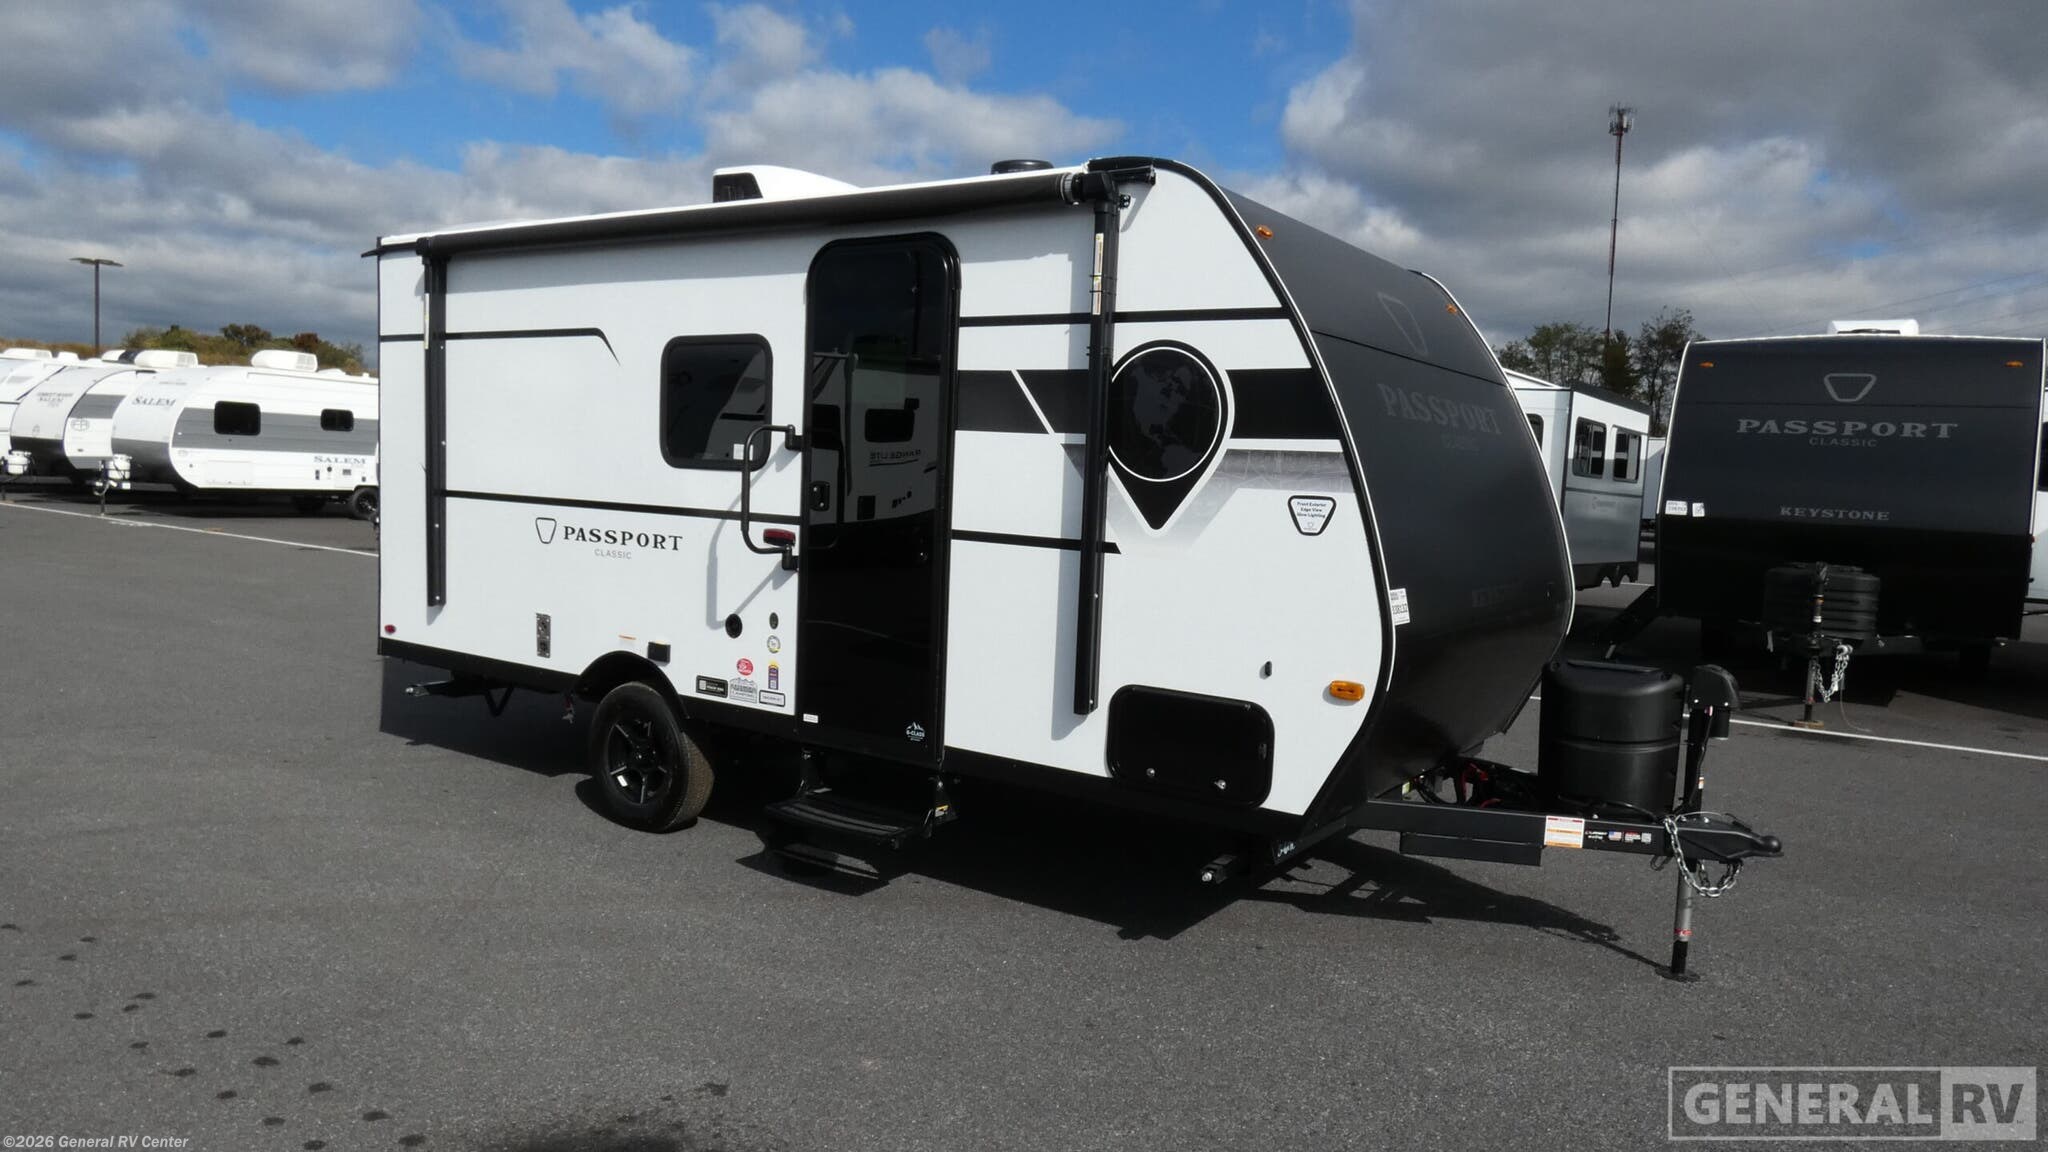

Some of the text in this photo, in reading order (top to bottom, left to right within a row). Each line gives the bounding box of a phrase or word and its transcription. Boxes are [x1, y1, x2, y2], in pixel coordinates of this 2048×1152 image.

[131, 395, 177, 407] SALEM
[1377, 383, 1503, 435] PASSPORT
[1736, 418, 1958, 439] PASSPORT
[1808, 437, 1878, 448] CLASSIC
[313, 455, 366, 465] SALEM
[1780, 506, 1890, 521] KEYSTONE
[563, 525, 683, 551] PASSPORT
[594, 548, 632, 560] CLASSIC
